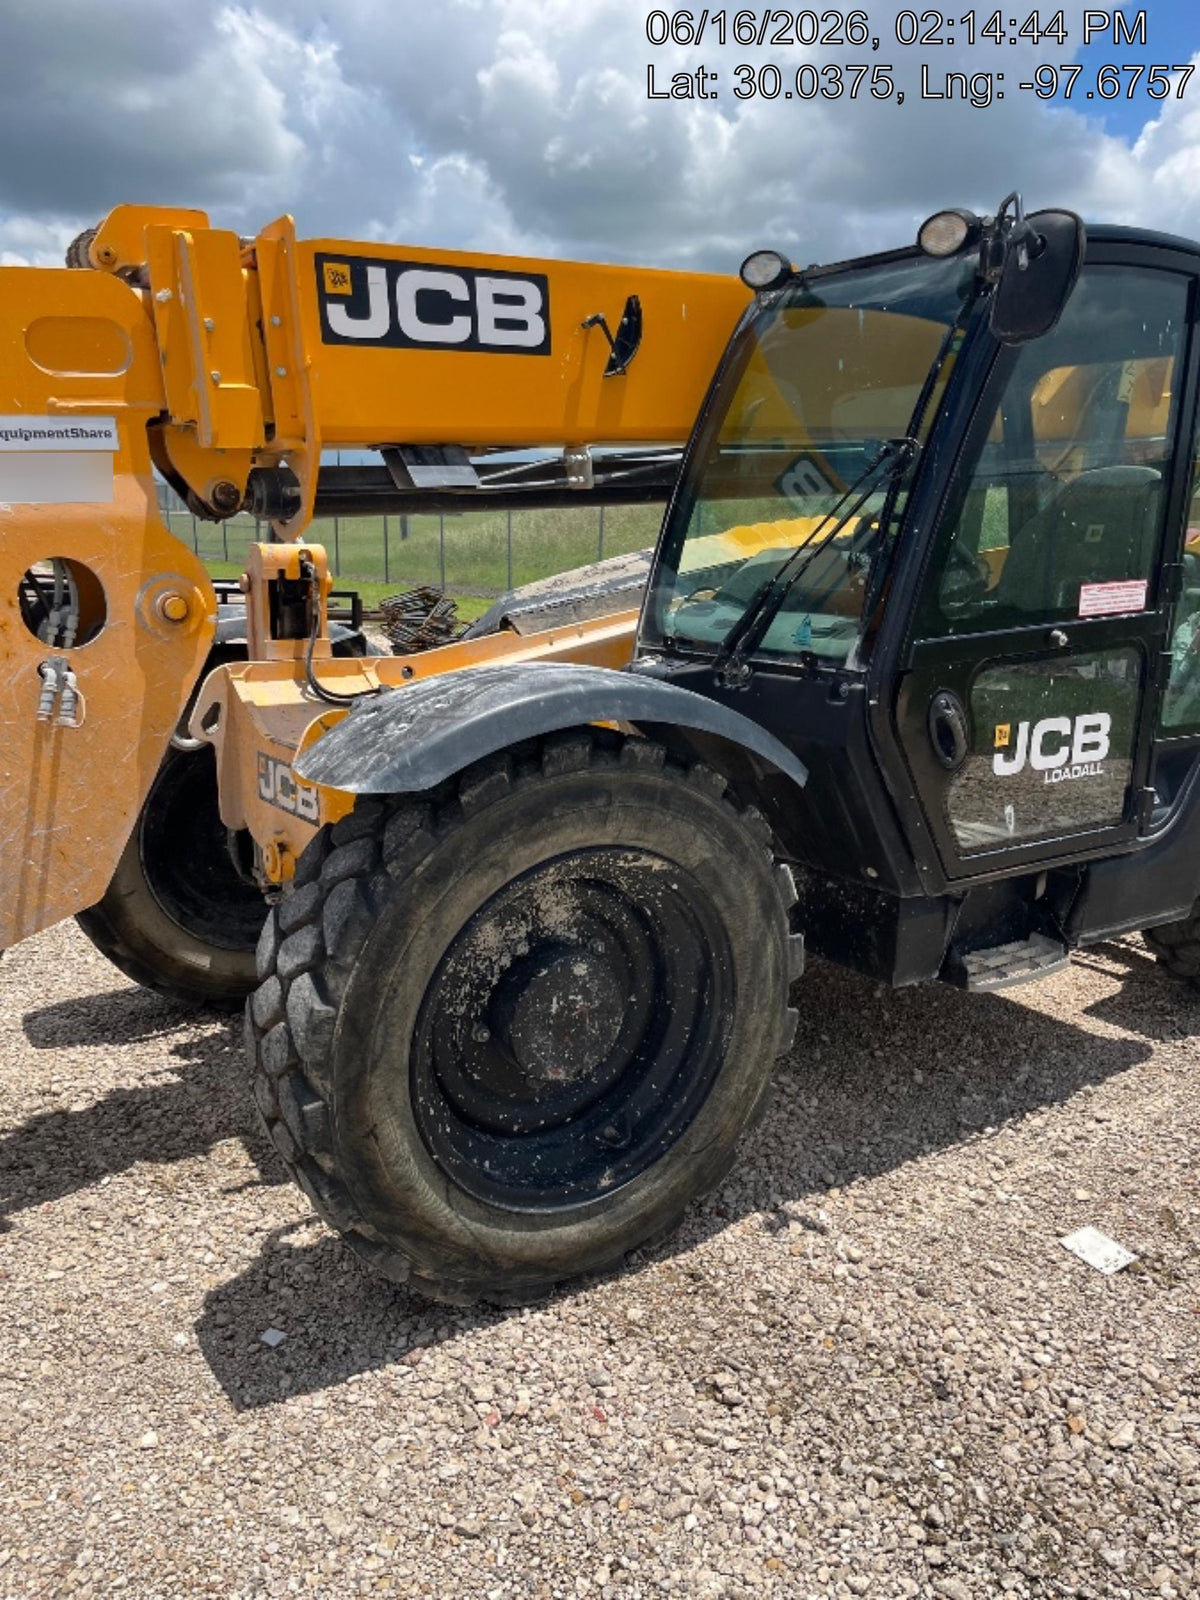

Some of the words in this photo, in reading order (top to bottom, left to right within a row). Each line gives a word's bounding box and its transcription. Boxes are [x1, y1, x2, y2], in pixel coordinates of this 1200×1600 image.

[326, 266, 546, 347] JCB
[0, 428, 112, 441] quipmentShare
[993, 712, 1111, 776] JCB
[1044, 762, 1104, 784] LOADALL
[259, 760, 318, 820] JCB
